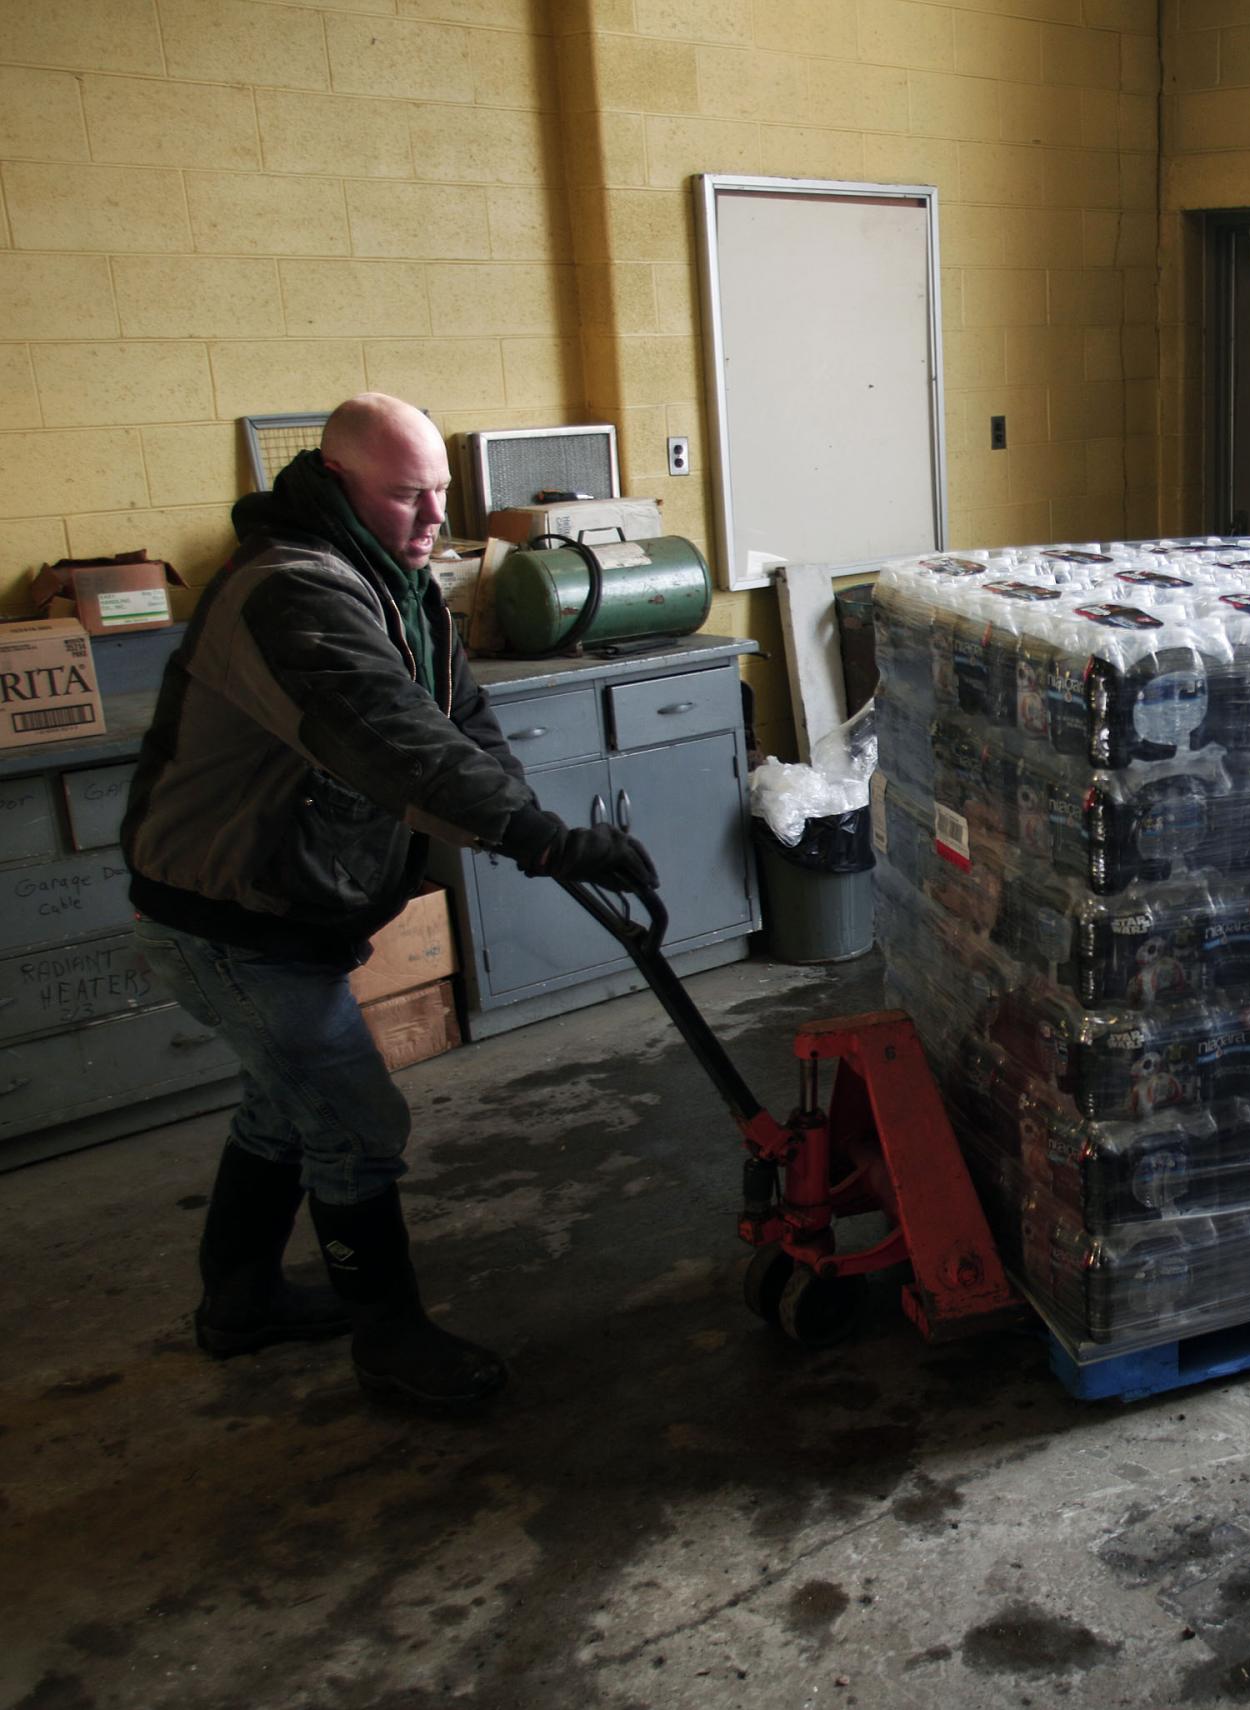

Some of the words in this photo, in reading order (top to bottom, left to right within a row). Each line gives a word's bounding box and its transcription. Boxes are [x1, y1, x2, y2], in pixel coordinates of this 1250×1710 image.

[15, 875, 92, 897] Garage
[38, 896, 83, 916] Cable
[1111, 914, 1150, 927] STAR
[1112, 924, 1150, 936] WARS
[20, 948, 119, 985] RADIANT
[40, 969, 152, 1010] HEATERS
[1107, 1037, 1144, 1050] WARS
[1109, 1030, 1144, 1041] STAR
